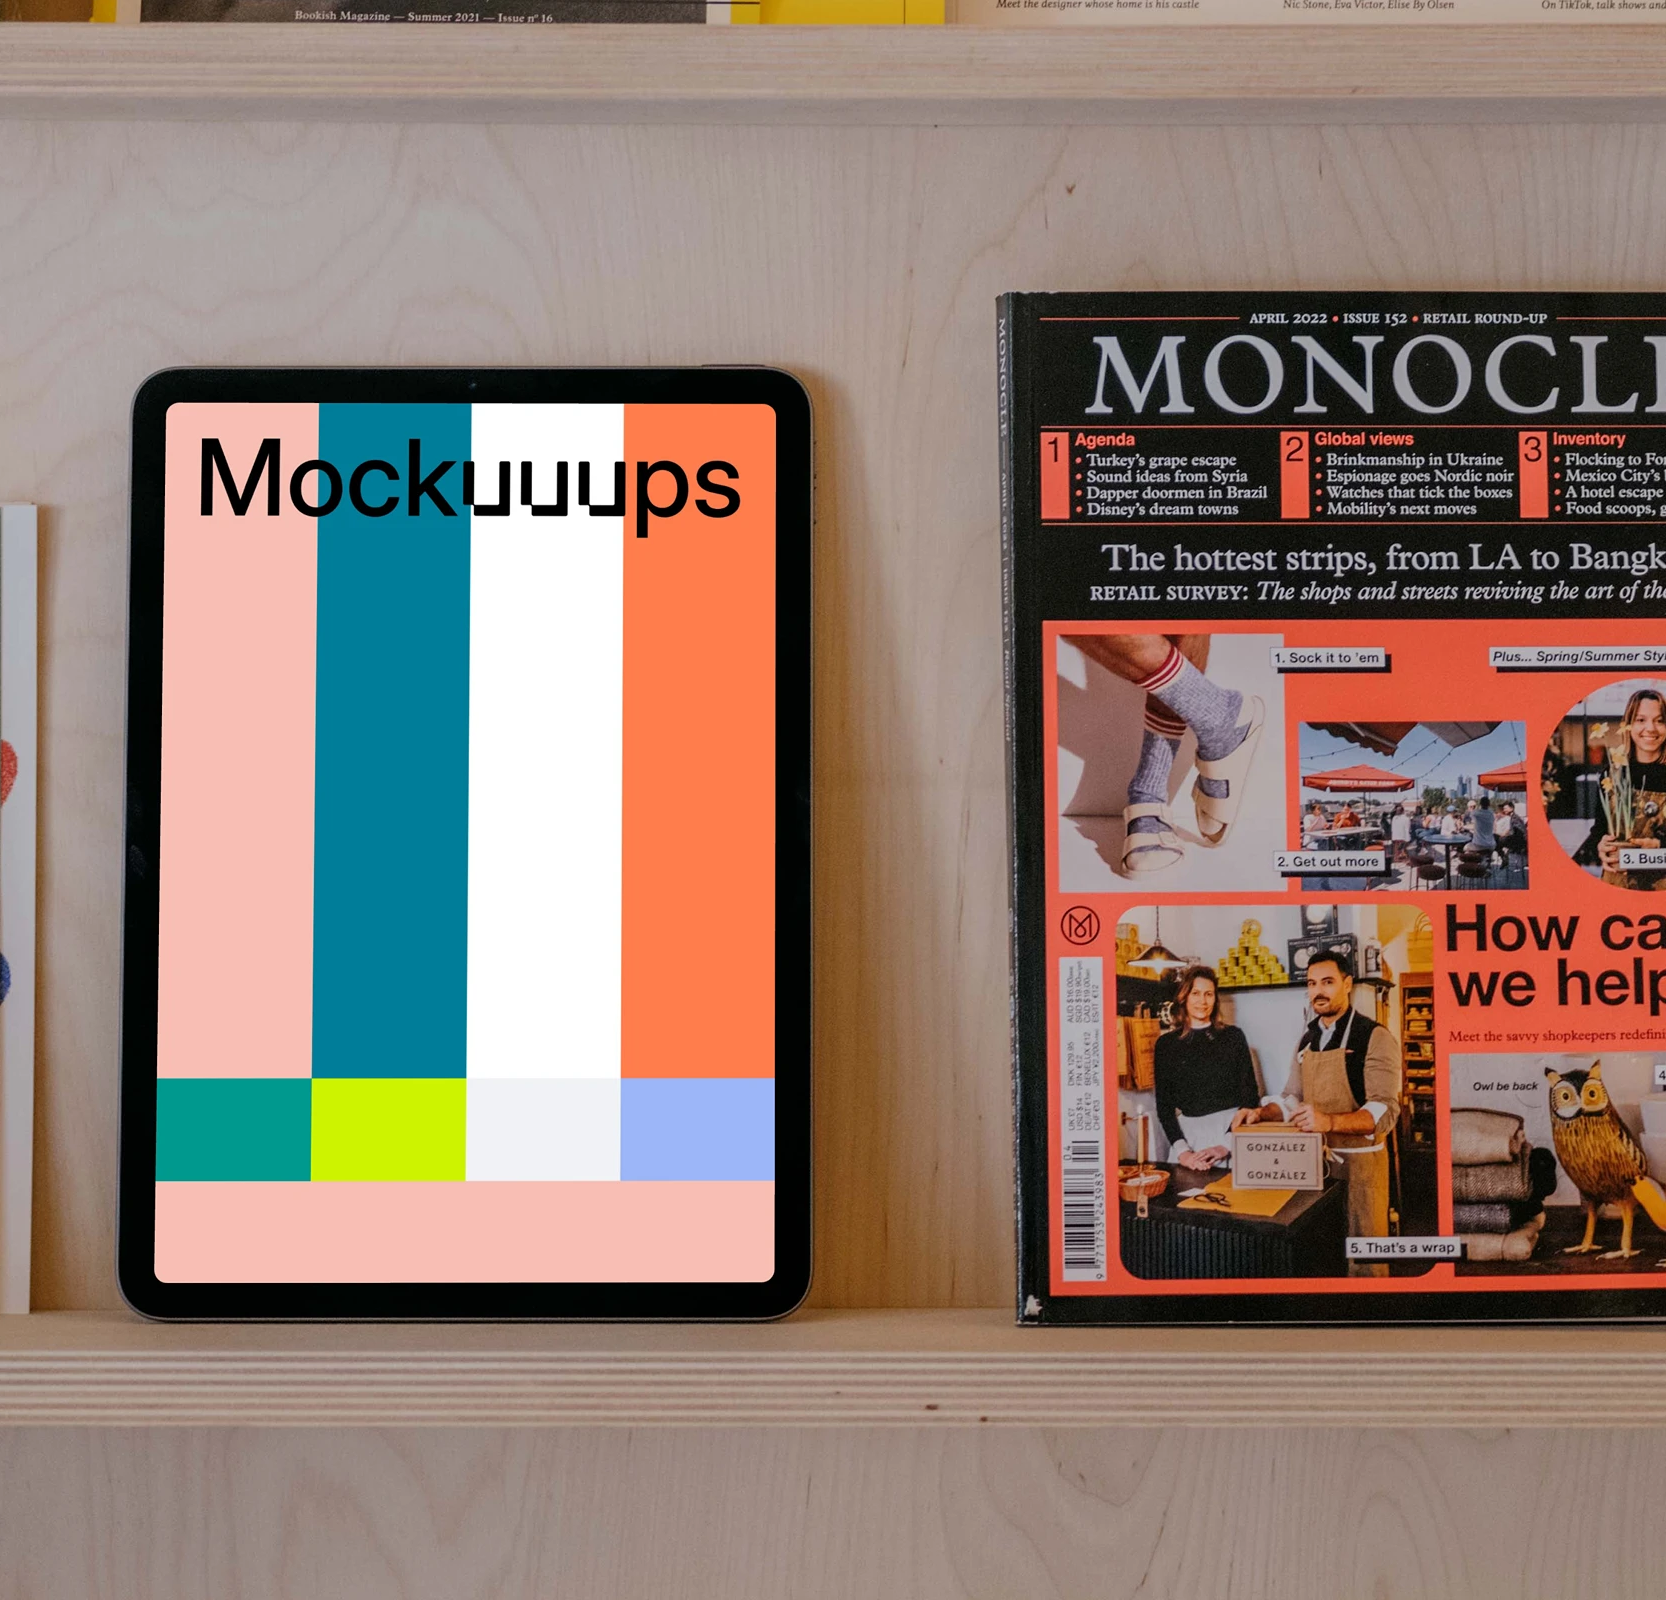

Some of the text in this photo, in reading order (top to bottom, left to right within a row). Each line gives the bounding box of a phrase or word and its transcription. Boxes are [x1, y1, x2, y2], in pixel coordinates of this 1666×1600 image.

[294, 10, 337, 21] Bookish
[339, 10, 391, 22] Magazine
[407, 12, 453, 22] Summer
[454, 12, 480, 22] 2021
[497, 12, 525, 23] Issue
[540, 13, 553, 23] 16
[1249, 312, 1548, 327] APRIL 2022 ISSUE 152 RETAIL ROUND-UP
[1047, 432, 1136, 463] 1 Agenda
[1285, 431, 1415, 462] 2 Global views
[1524, 431, 1627, 463] 3 Inventory
[199, 437, 742, 539] Mockuuups
[1101, 543, 1166, 572] The
[1173, 543, 1278, 572] hottest
[1285, 543, 1377, 577] strips,
[1385, 542, 1461, 571] from
[1468, 543, 1523, 570] LA
[1529, 548, 1560, 571] to
[1089, 585, 1161, 601] RETAIL
[1166, 585, 1249, 601] SURVEY:
[1256, 580, 1296, 601] The
[1299, 580, 1353, 605] shops
[1357, 580, 1398, 601] and
[1400, 584, 1459, 601] streets
[1464, 579, 1546, 605] reviving
[1549, 579, 1580, 600] the
[1584, 584, 1615, 600] art
[1618, 579, 1642, 604] of
[1274, 652, 1286, 663] 1.
[1289, 652, 1323, 663] Sock
[1325, 652, 1335, 663] it
[1338, 652, 1352, 663] to
[1492, 651, 1533, 662] Plus...
[1535, 650, 1640, 664] Spring/Summer
[1622, 853, 1635, 865] 3.
[1446, 903, 1580, 952] How
[1447, 970, 1536, 1008] we
[1472, 1081, 1539, 1092] Owl be back
[1246, 1143, 1306, 1153] GONZÁLEZ
[1273, 1157, 1280, 1165] &
[1247, 1170, 1307, 1181] GONZÁLEZ
